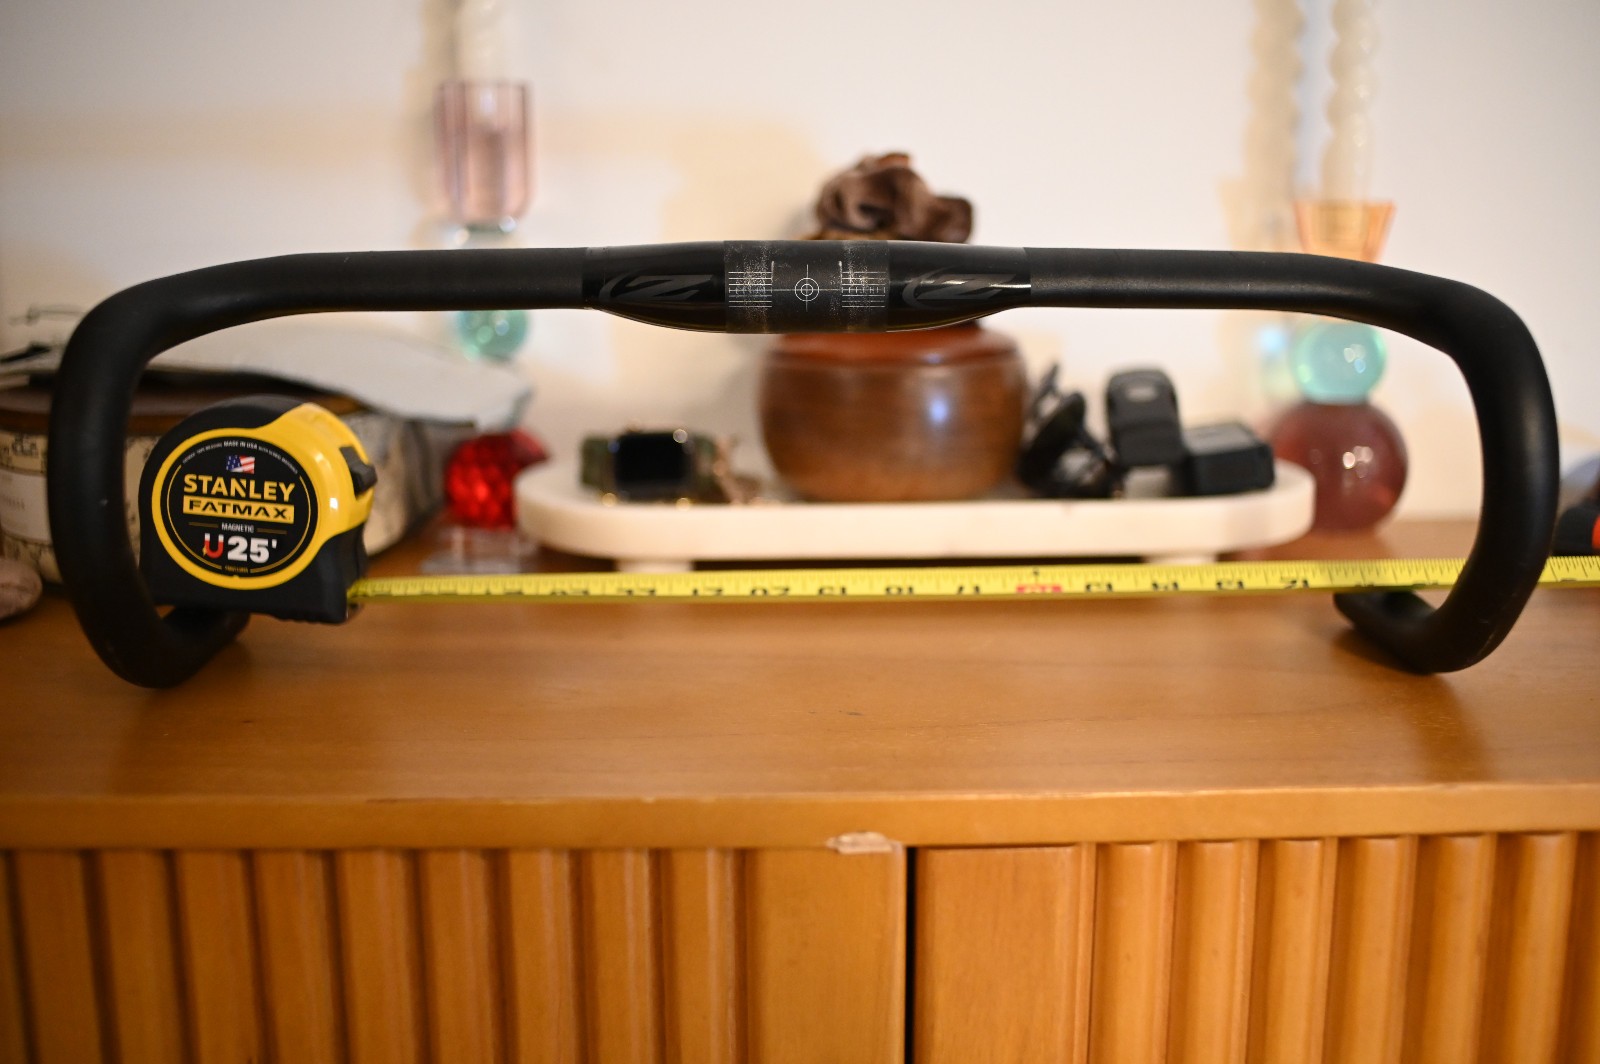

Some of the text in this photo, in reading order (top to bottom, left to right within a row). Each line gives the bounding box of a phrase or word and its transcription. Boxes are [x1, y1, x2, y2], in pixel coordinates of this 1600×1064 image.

[223, 440, 239, 448] MADE
[246, 442, 258, 450] USA
[183, 474, 296, 502] STANLEY
[188, 498, 288, 520] FATMAX
[221, 522, 255, 534] MAGNETIC
